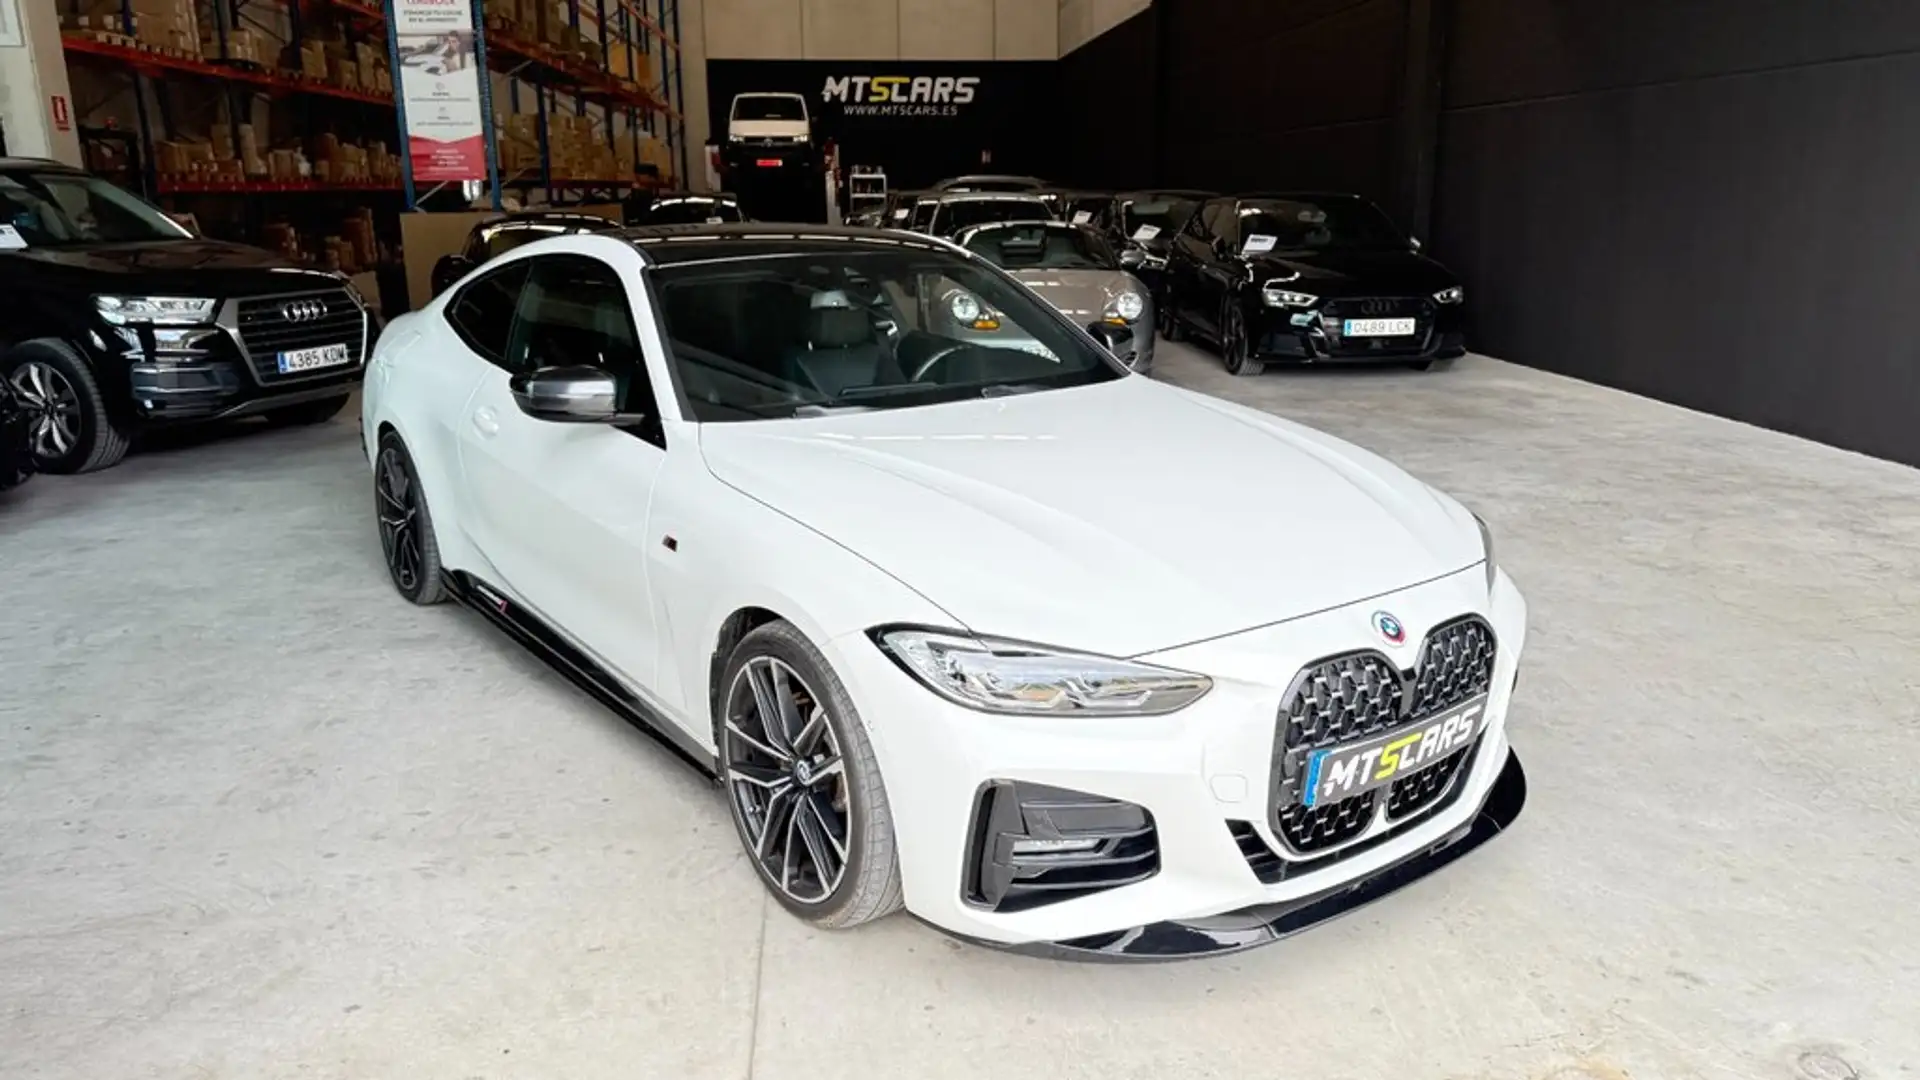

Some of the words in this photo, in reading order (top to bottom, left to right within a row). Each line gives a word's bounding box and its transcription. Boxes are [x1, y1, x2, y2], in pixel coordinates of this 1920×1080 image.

[821, 76, 981, 103] MTSCARS
[843, 105, 958, 116] WWW.MTSCARS.ES
[1323, 705, 1481, 797] MTSCARS
